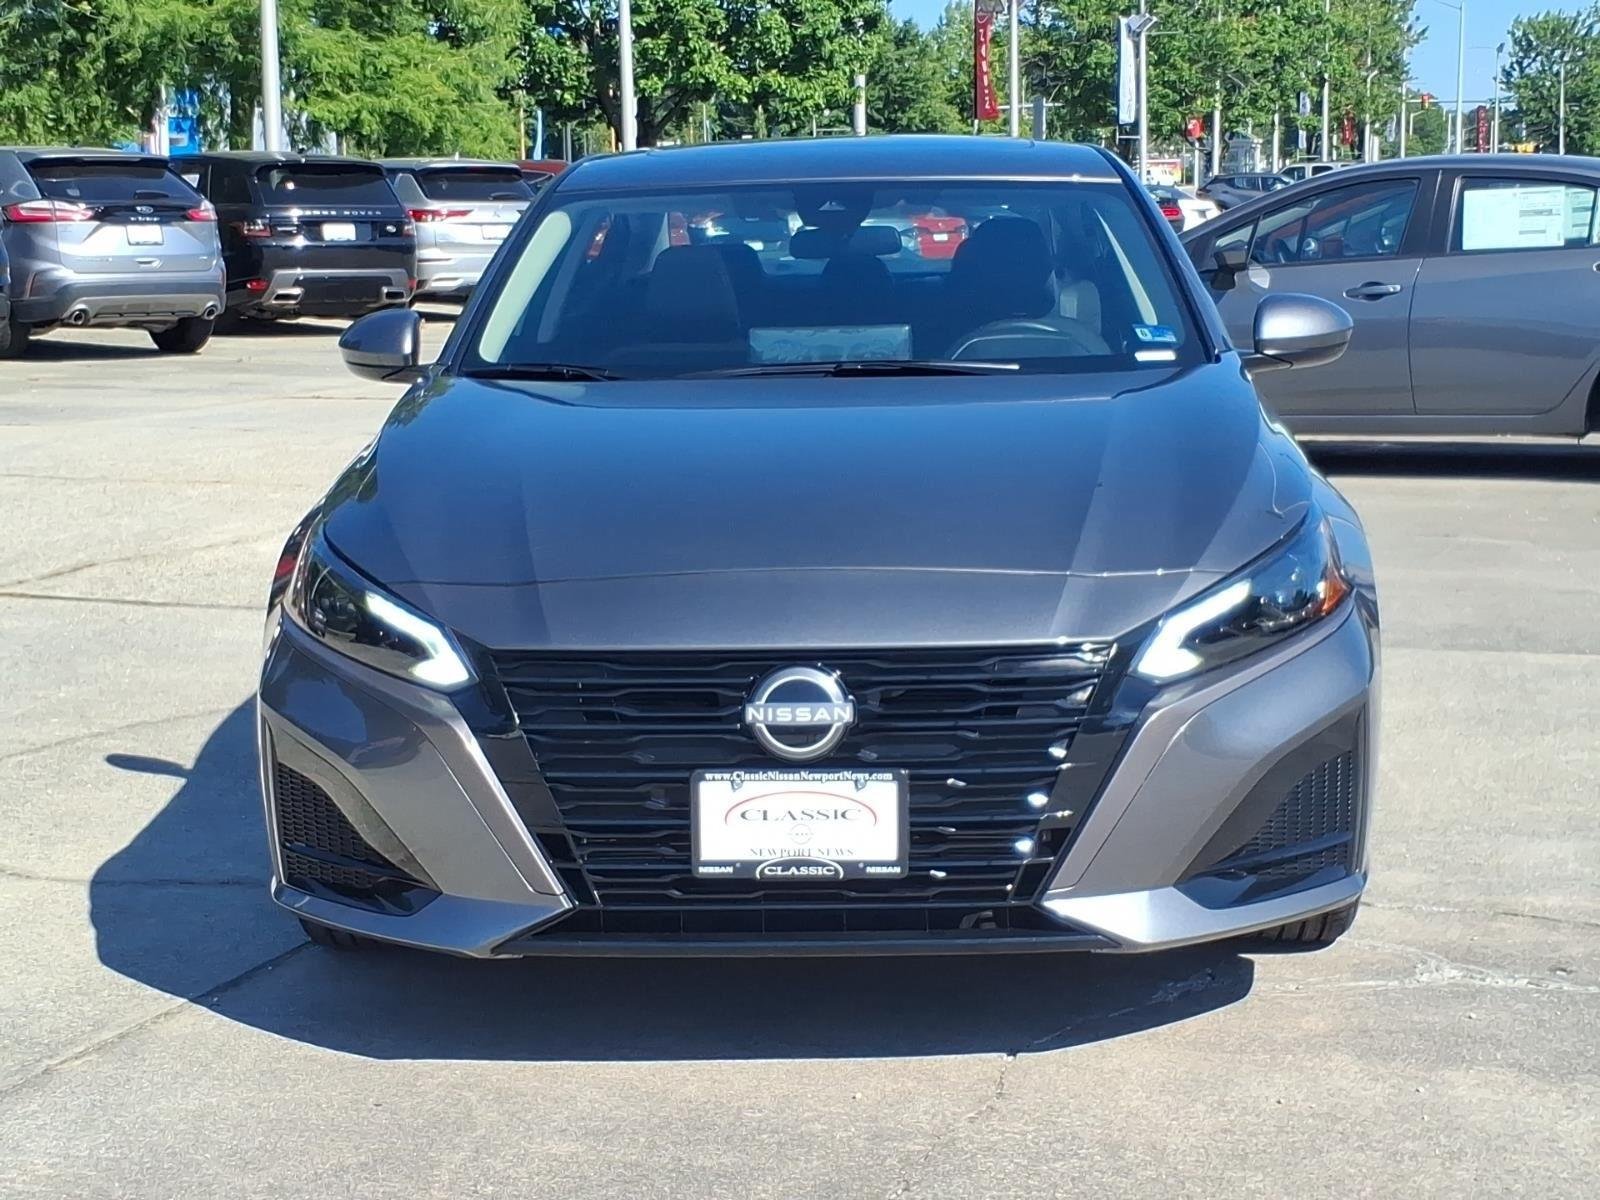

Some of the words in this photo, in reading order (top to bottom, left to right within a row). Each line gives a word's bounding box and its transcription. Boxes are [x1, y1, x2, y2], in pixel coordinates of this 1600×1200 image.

[747, 706, 851, 722] NISSAN
[704, 771, 894, 783] www.ClassicNissanNewportNews.com
[740, 808, 861, 822] CLASSIC
[750, 848, 812, 858] NEWPORT
[817, 848, 855, 857] NEWS
[698, 865, 734, 874] NISSAN
[763, 865, 836, 876] CLASSIC
[865, 865, 902, 874] NISSAN
